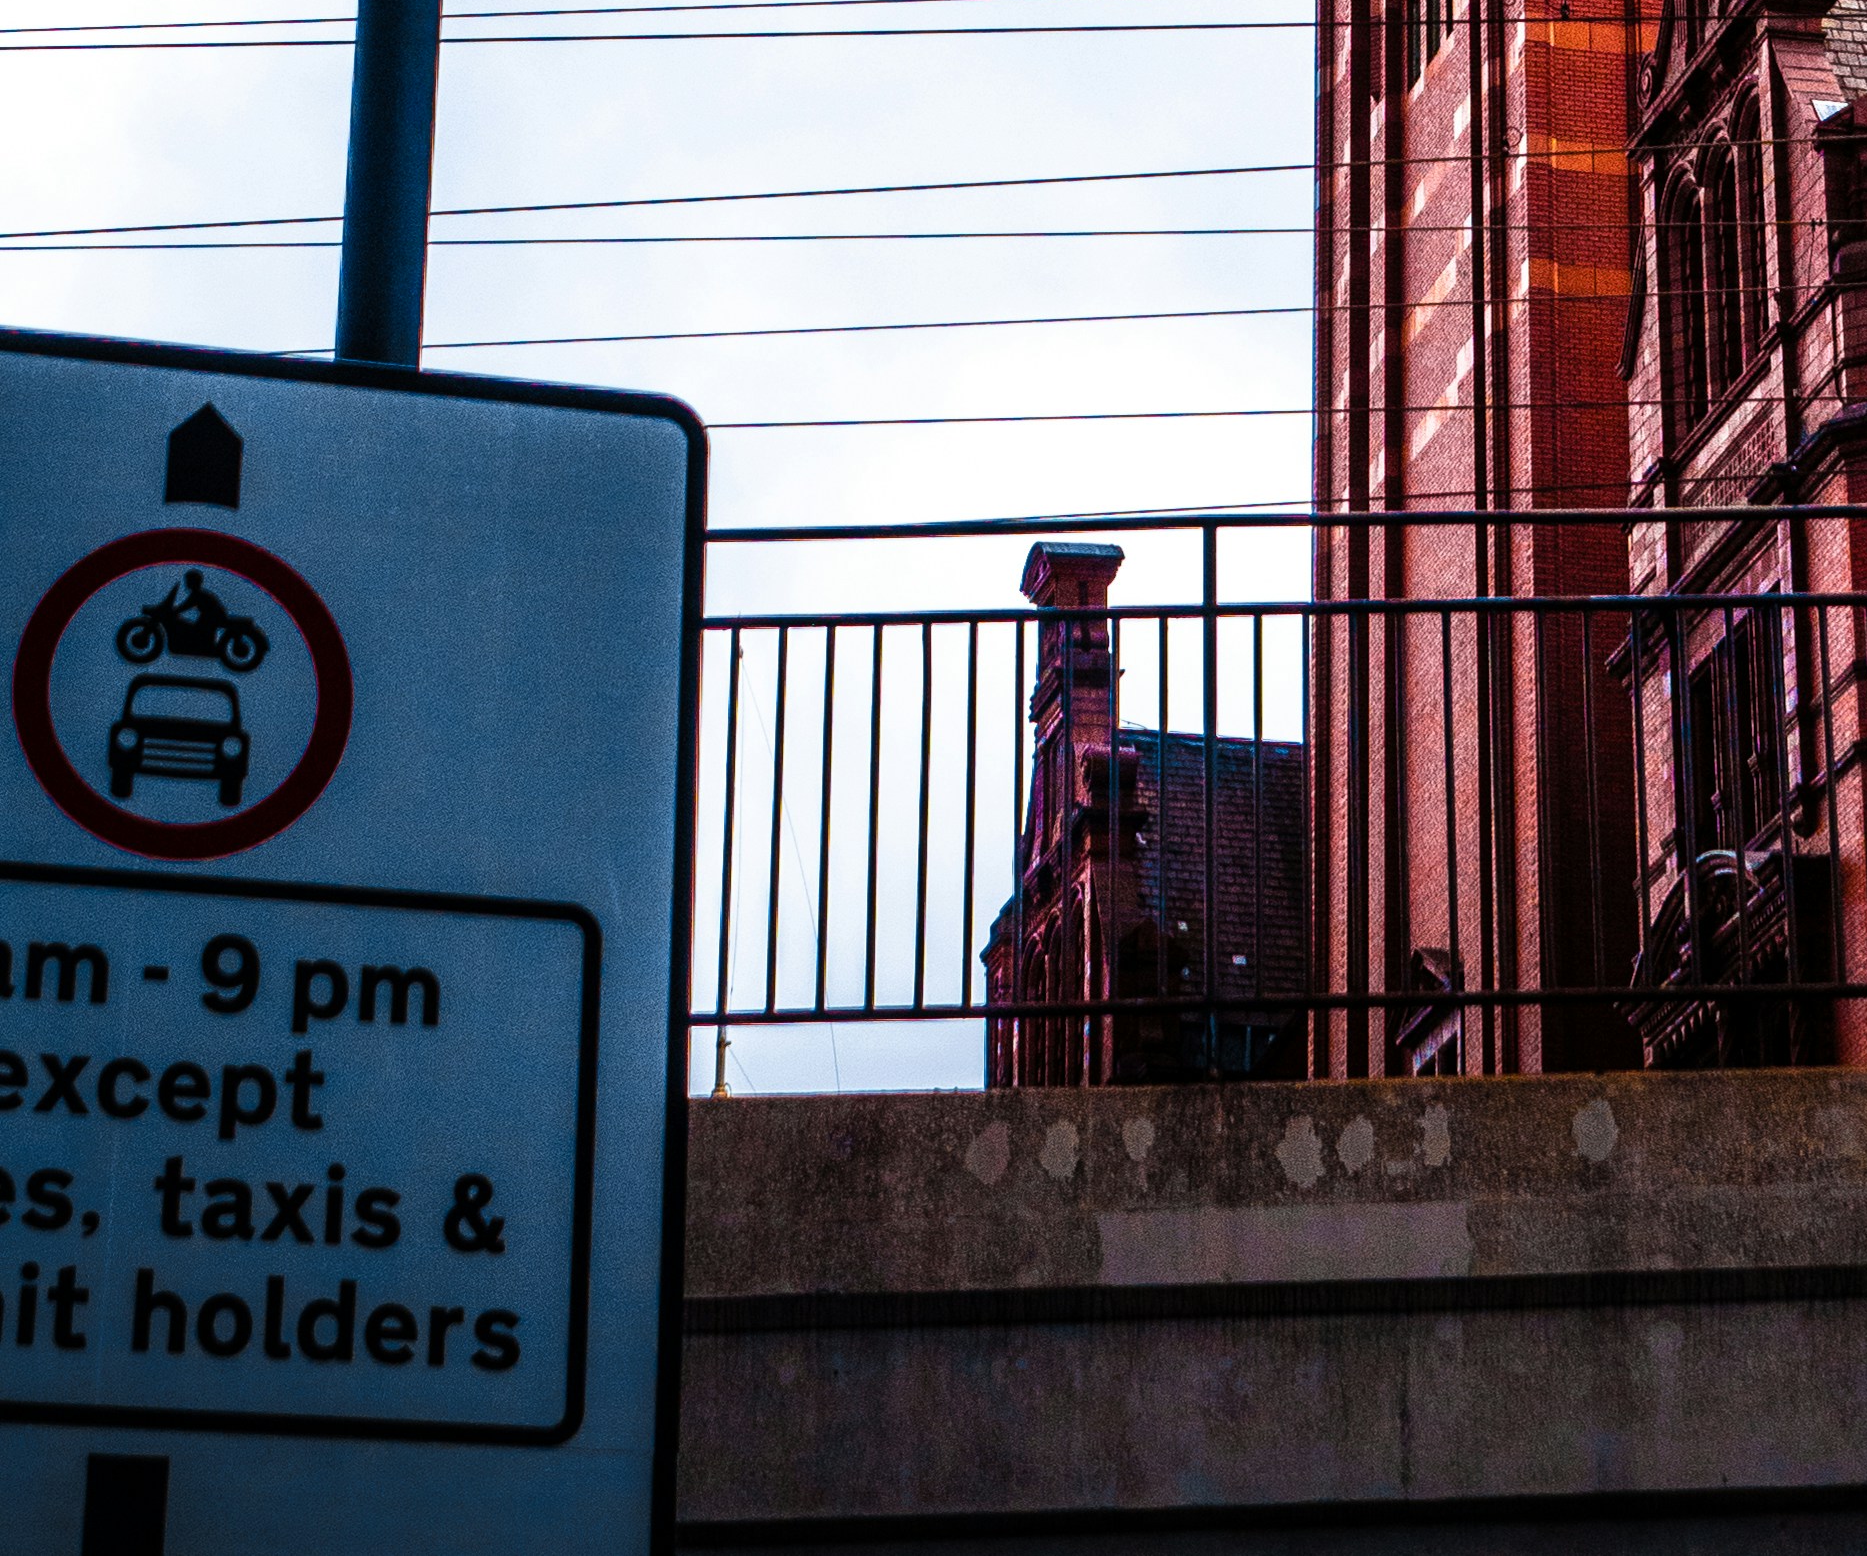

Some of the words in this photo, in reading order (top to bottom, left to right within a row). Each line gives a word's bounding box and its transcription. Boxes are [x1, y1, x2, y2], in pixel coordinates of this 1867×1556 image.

[0, 940, 110, 1005] m
[291, 960, 440, 1034] pm
[0, 1049, 325, 1142] except
[154, 1156, 402, 1252] taxis
[443, 1173, 506, 1255] &
[0, 1261, 90, 1353] it
[130, 1268, 521, 1374] holders
